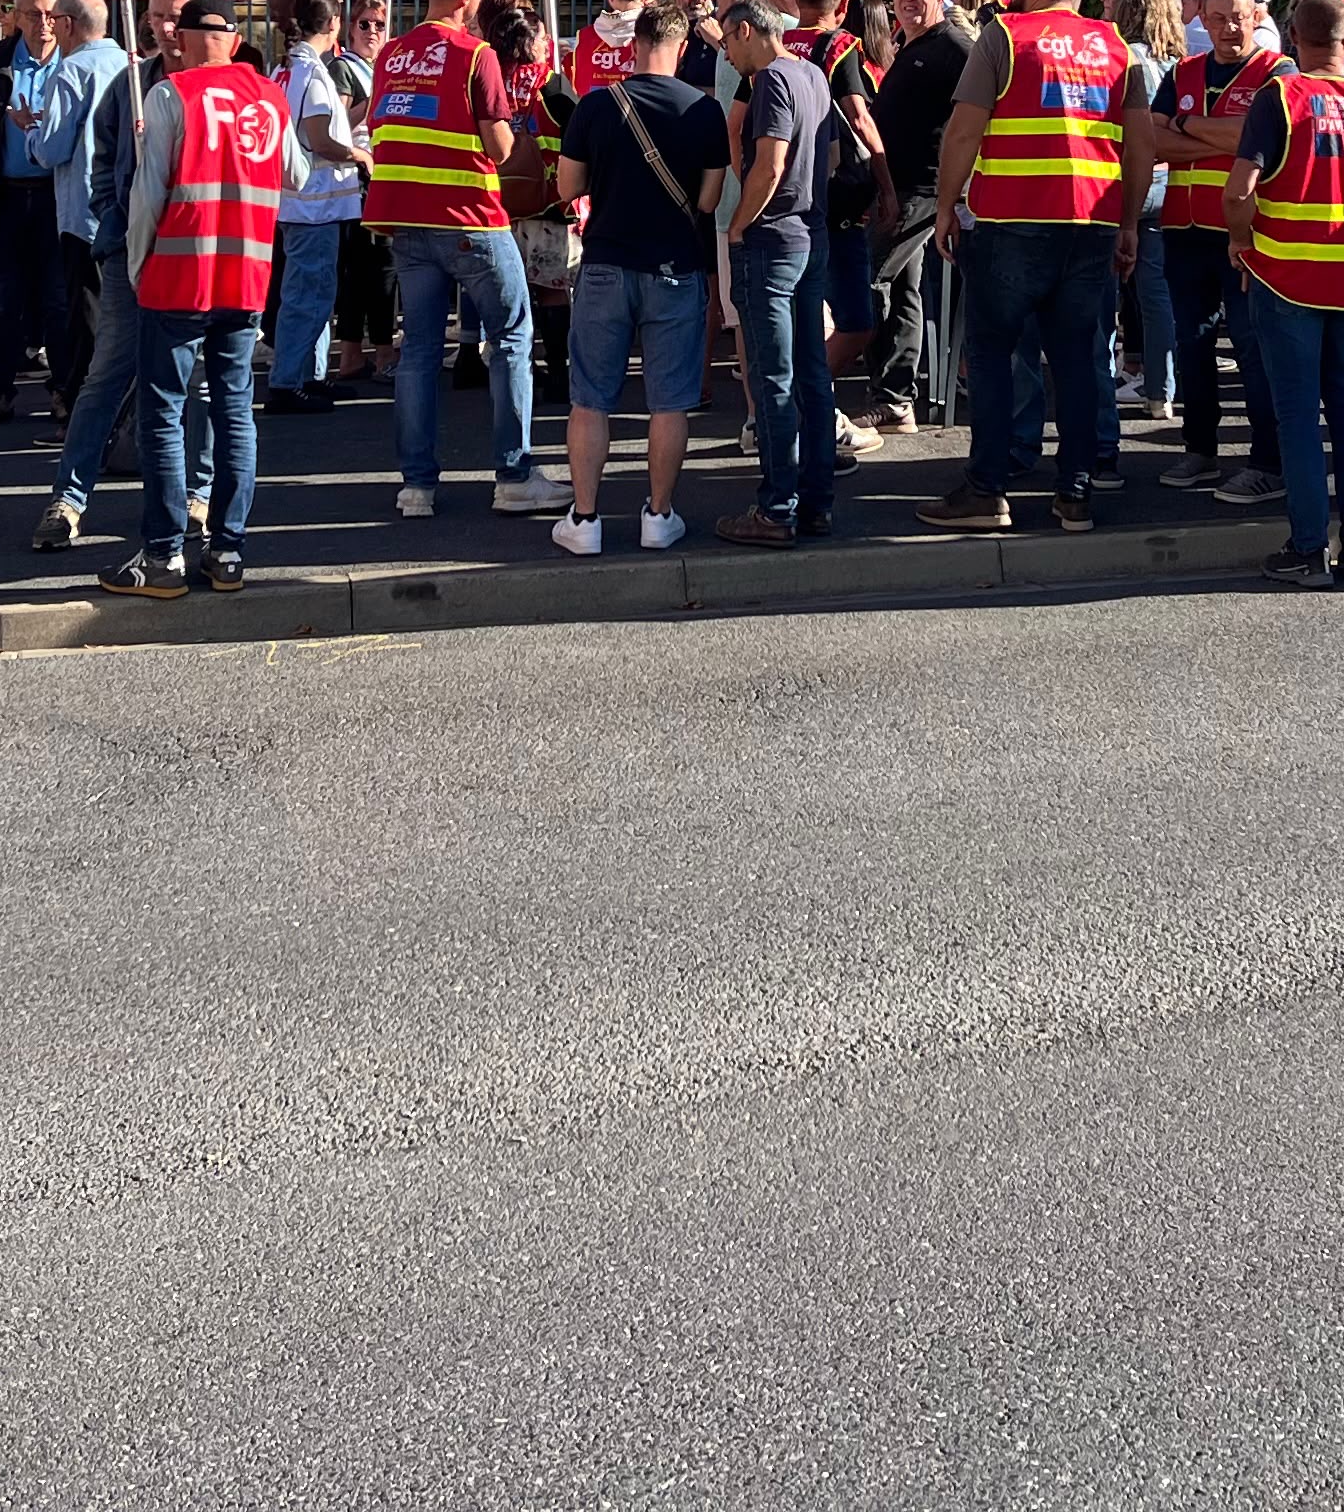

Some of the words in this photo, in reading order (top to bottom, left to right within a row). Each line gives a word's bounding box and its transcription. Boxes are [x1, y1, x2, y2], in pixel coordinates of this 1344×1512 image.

[1037, 35, 1074, 59] cgt
[385, 49, 415, 73] cgt
[591, 49, 621, 69] cgt
[388, 93, 415, 104] EDF
[385, 104, 412, 115] GDF
